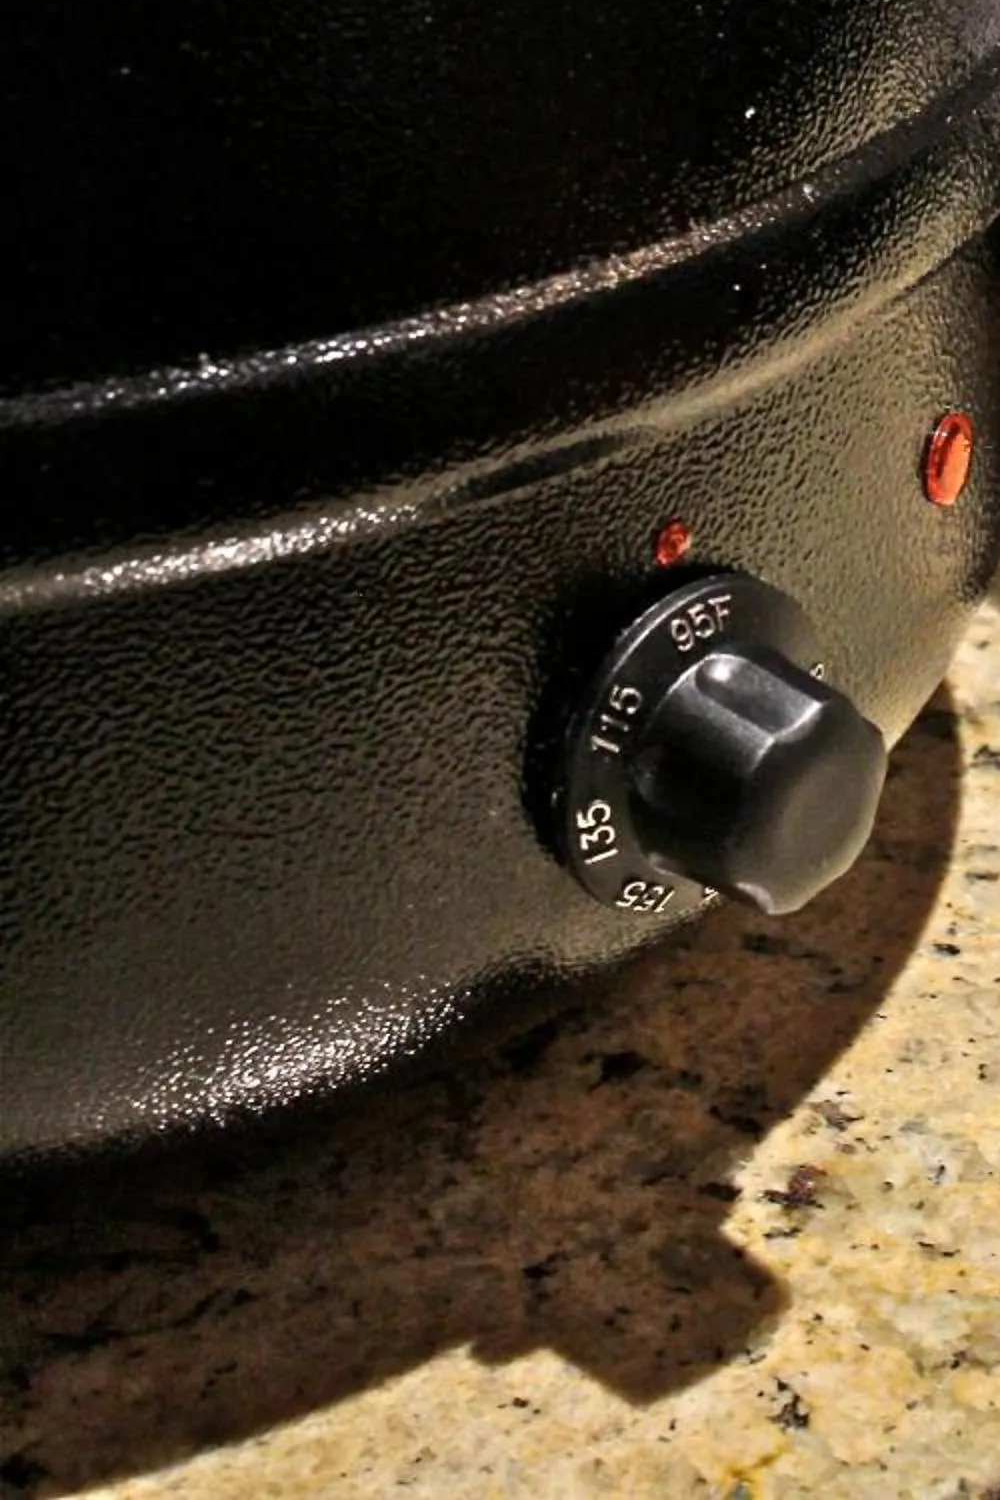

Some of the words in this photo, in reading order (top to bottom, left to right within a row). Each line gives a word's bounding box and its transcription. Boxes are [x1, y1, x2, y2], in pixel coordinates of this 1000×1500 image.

[671, 595, 731, 651] 95F
[591, 684, 643, 753] 115
[577, 799, 618, 865] 135
[615, 881, 676, 913] 155
